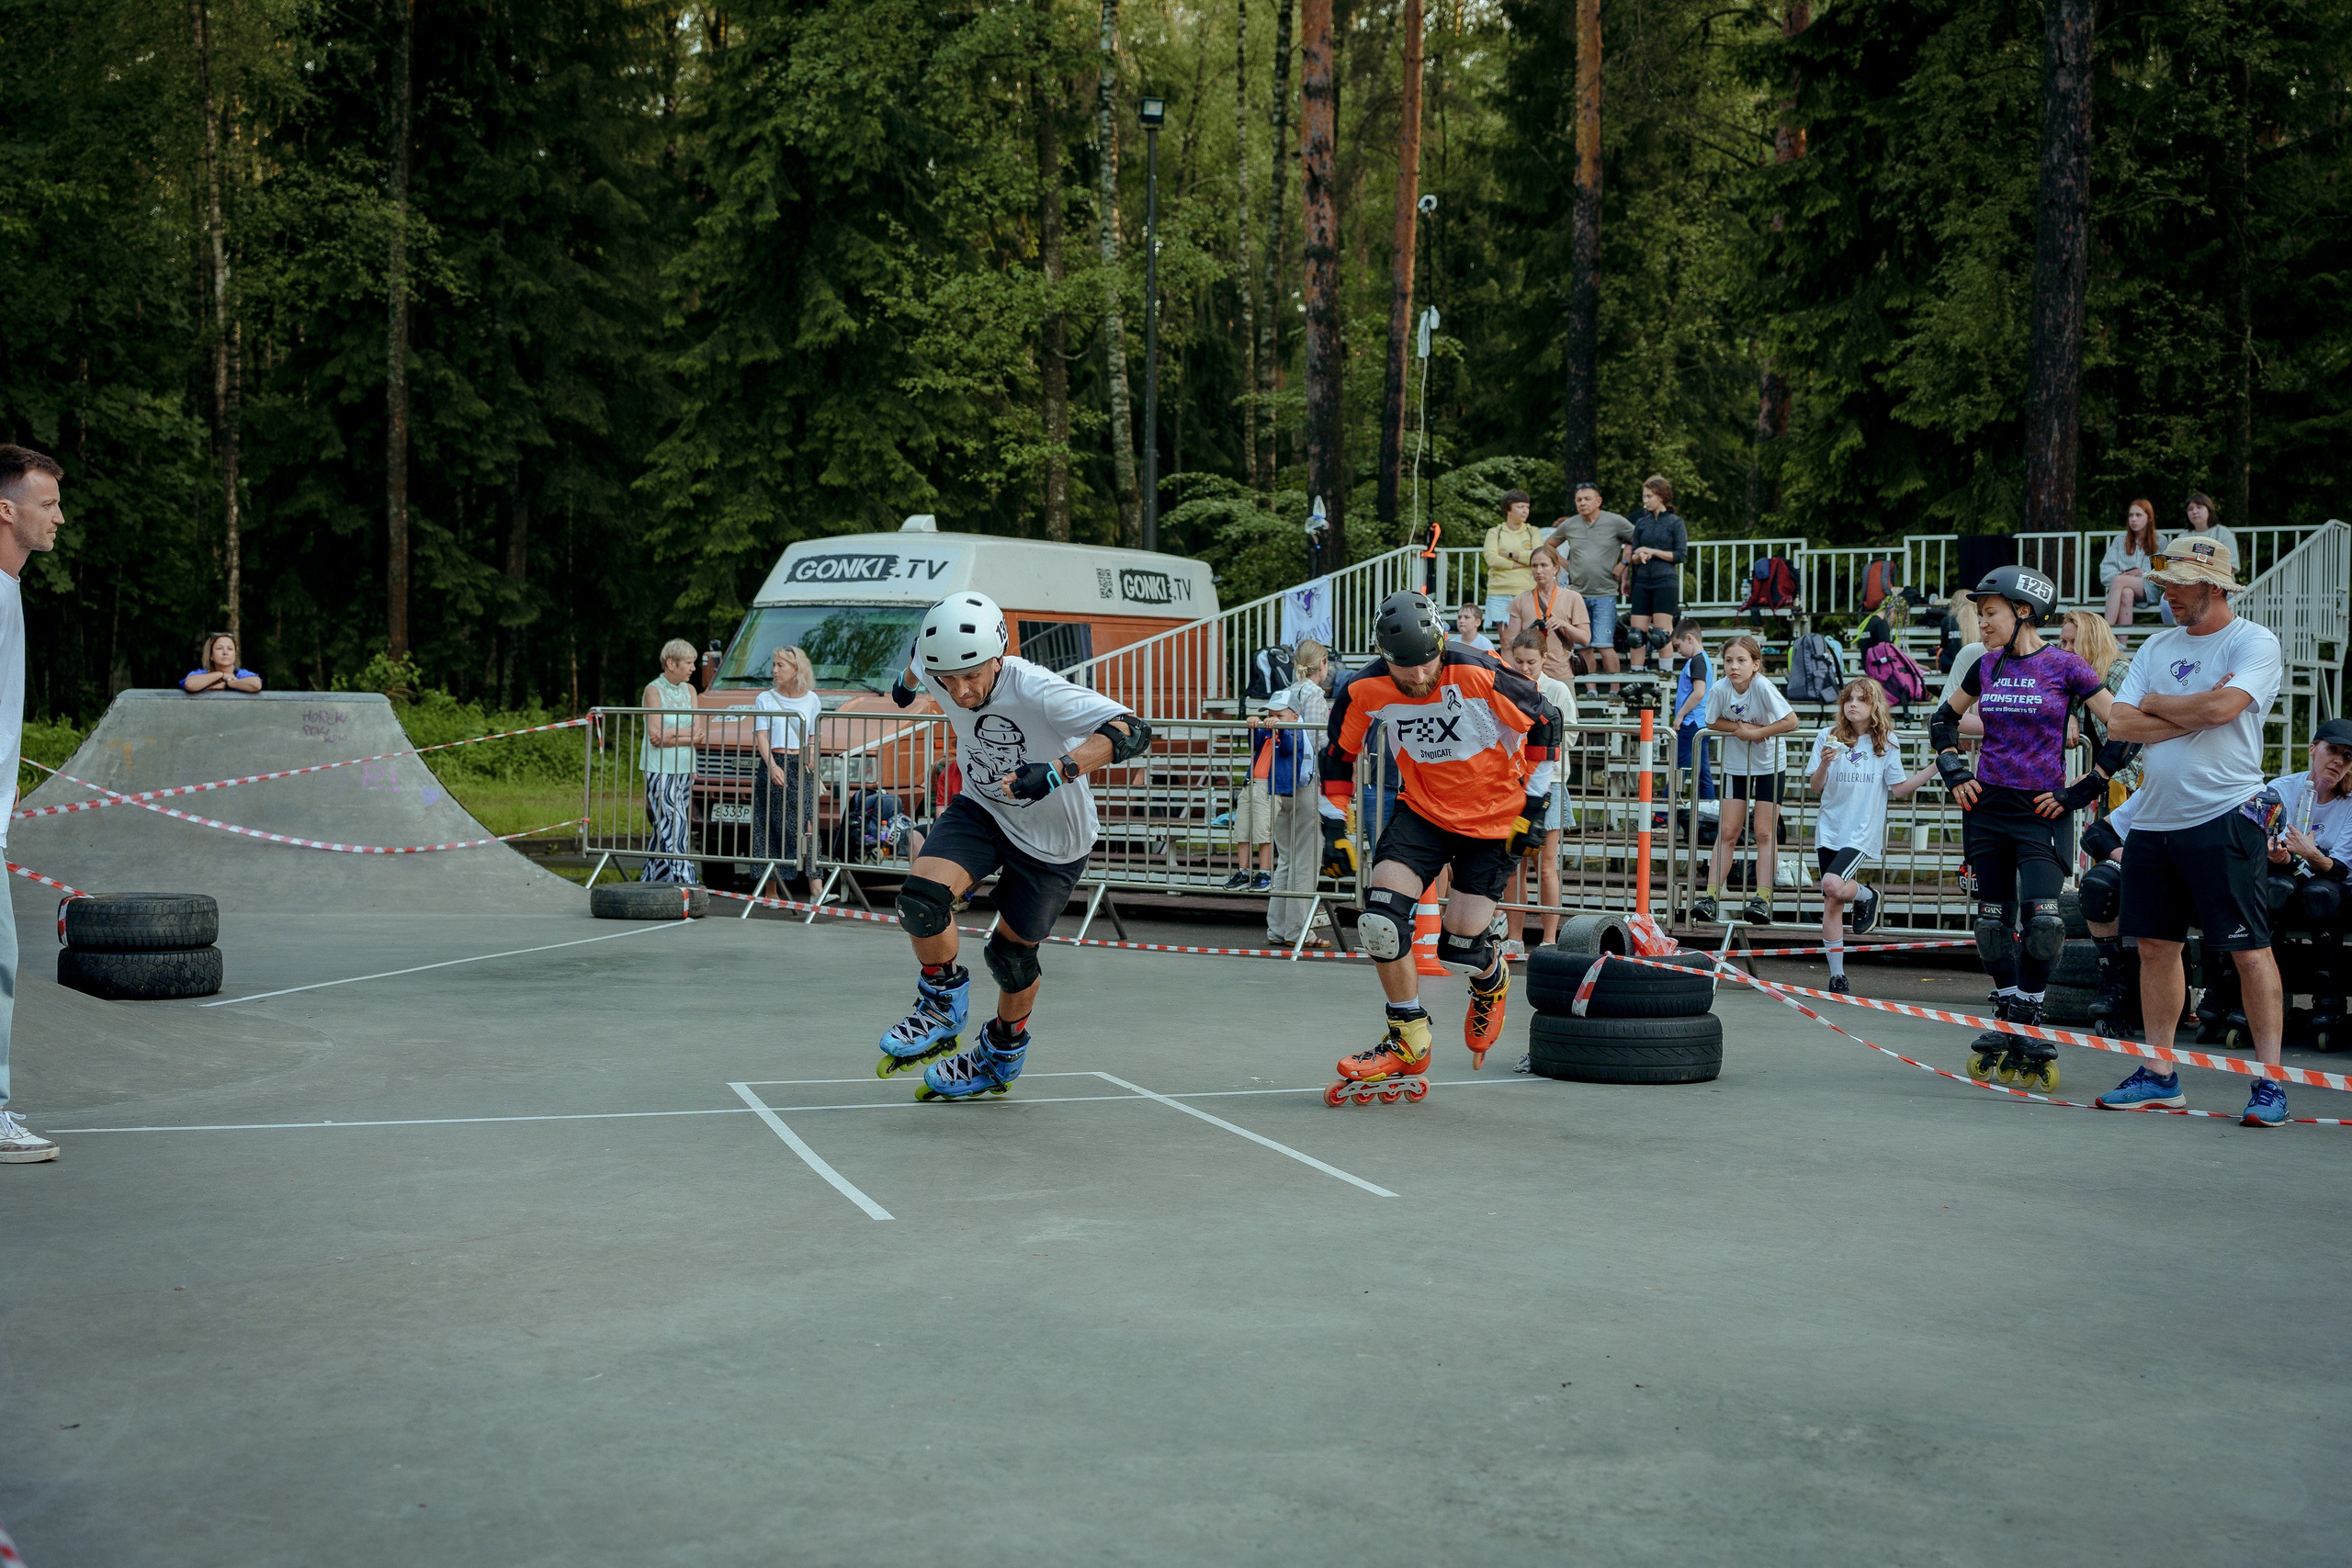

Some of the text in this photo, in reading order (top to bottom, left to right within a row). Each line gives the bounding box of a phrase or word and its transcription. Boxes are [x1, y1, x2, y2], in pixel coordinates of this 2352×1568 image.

[795, 558, 949, 581] GONKI.TV
[1123, 573, 1192, 602] GONKI.TV
[2021, 577, 2051, 600] 125
[1992, 677, 2036, 689] ROLLER
[1981, 694, 2043, 705] MONSTERS
[1419, 748, 1453, 760] SYNDICATE
